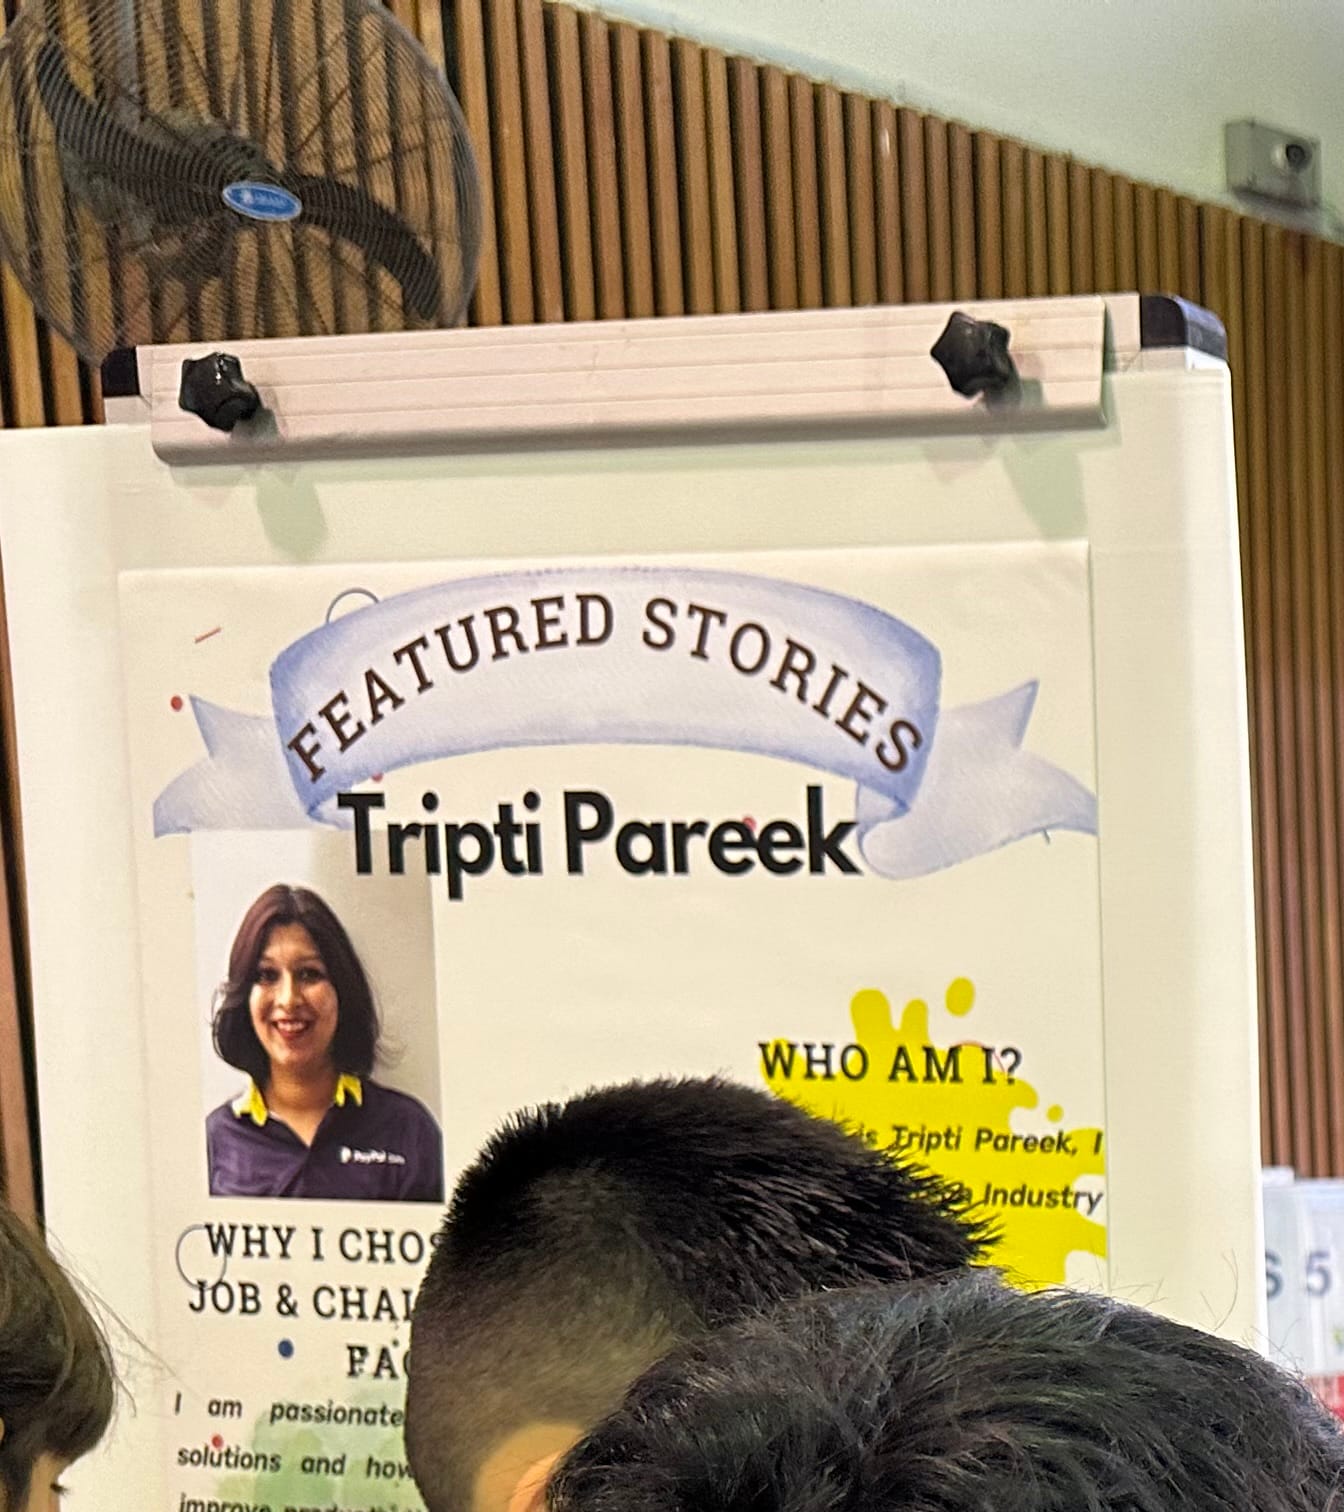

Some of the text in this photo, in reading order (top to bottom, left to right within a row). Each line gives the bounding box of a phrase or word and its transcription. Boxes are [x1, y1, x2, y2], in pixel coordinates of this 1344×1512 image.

[287, 593, 924, 784] FEATURED STORIES
[336, 784, 864, 901] Tripti Pareek
[758, 1041, 1022, 1086] WHO AM I?
[891, 1124, 963, 1156] Tripti
[974, 1127, 1079, 1157] Pareek,
[983, 1182, 1104, 1216] Industry
[205, 1224, 297, 1259] WHY
[311, 1228, 324, 1260] I
[189, 1280, 262, 1315] JOB
[276, 1284, 299, 1318] &
[174, 1391, 405, 1427] I am passionate
[177, 1445, 281, 1472] solutions
[301, 1454, 346, 1476] and
